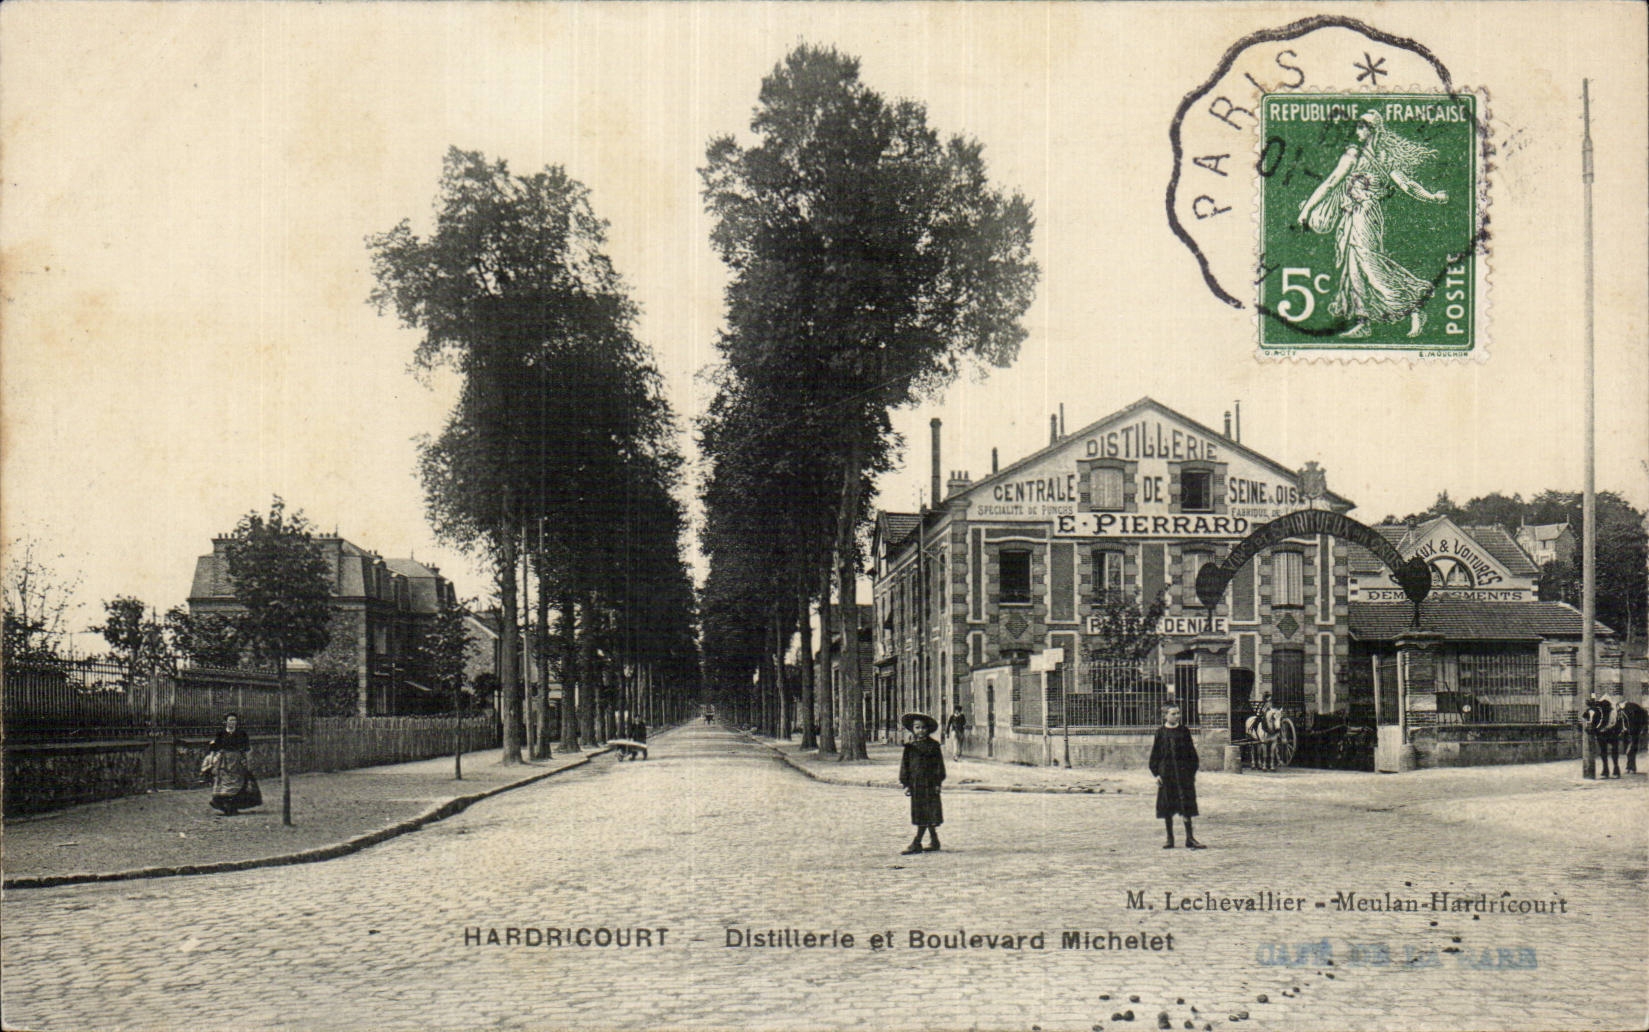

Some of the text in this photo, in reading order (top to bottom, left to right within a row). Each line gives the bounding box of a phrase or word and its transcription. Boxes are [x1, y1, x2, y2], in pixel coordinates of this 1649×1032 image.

[1086, 422, 1217, 460] DISTILLERIE
[993, 474, 1076, 502] CENTRALE
[1143, 476, 1163, 503] DE
[1229, 477, 1267, 504] SEINE
[1092, 514, 1248, 535] PIERRARD
[1439, 539, 1450, 553] &
[1454, 538, 1503, 587] VOITURES
